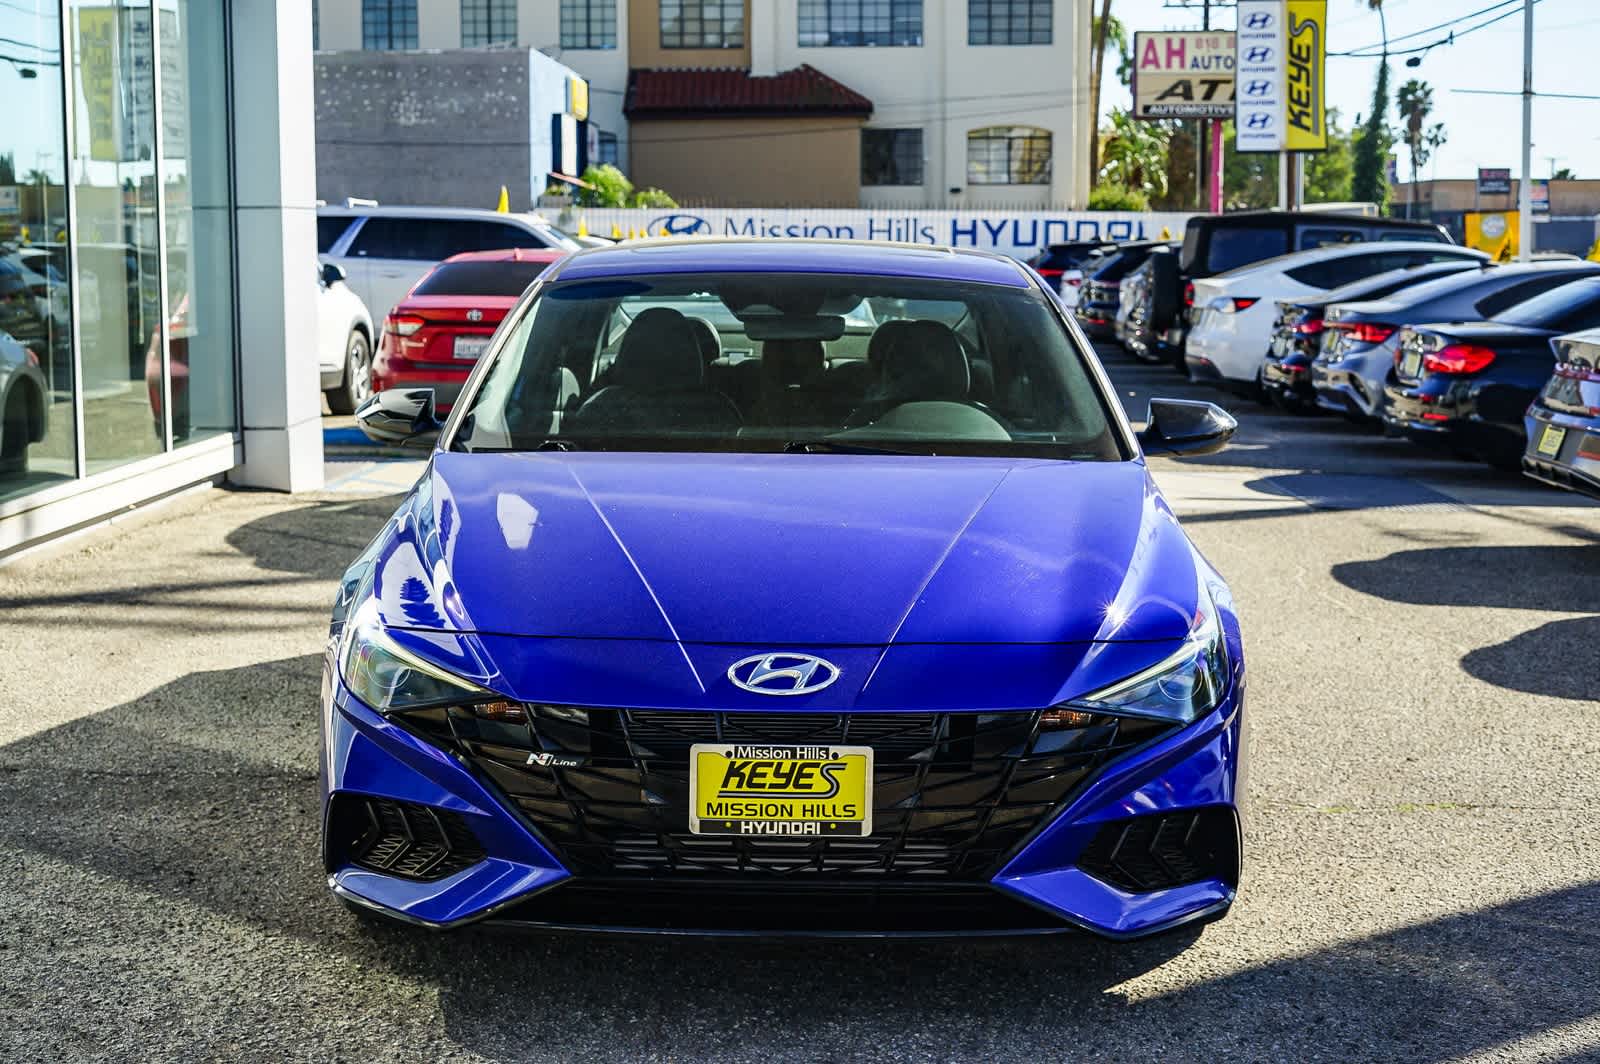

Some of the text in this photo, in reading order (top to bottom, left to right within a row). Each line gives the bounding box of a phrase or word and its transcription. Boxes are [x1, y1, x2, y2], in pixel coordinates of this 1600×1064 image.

[1141, 36, 1185, 70] AH
[1287, 11, 1319, 136] KEYES
[1154, 79, 1236, 102] AT
[724, 217, 1145, 247] Mission Hills HYUNDAI
[737, 747, 828, 760] Mission Hills
[718, 761, 848, 799] KEYES
[706, 802, 857, 818] MISSION HILLS
[740, 821, 821, 835] HYUNDAI
